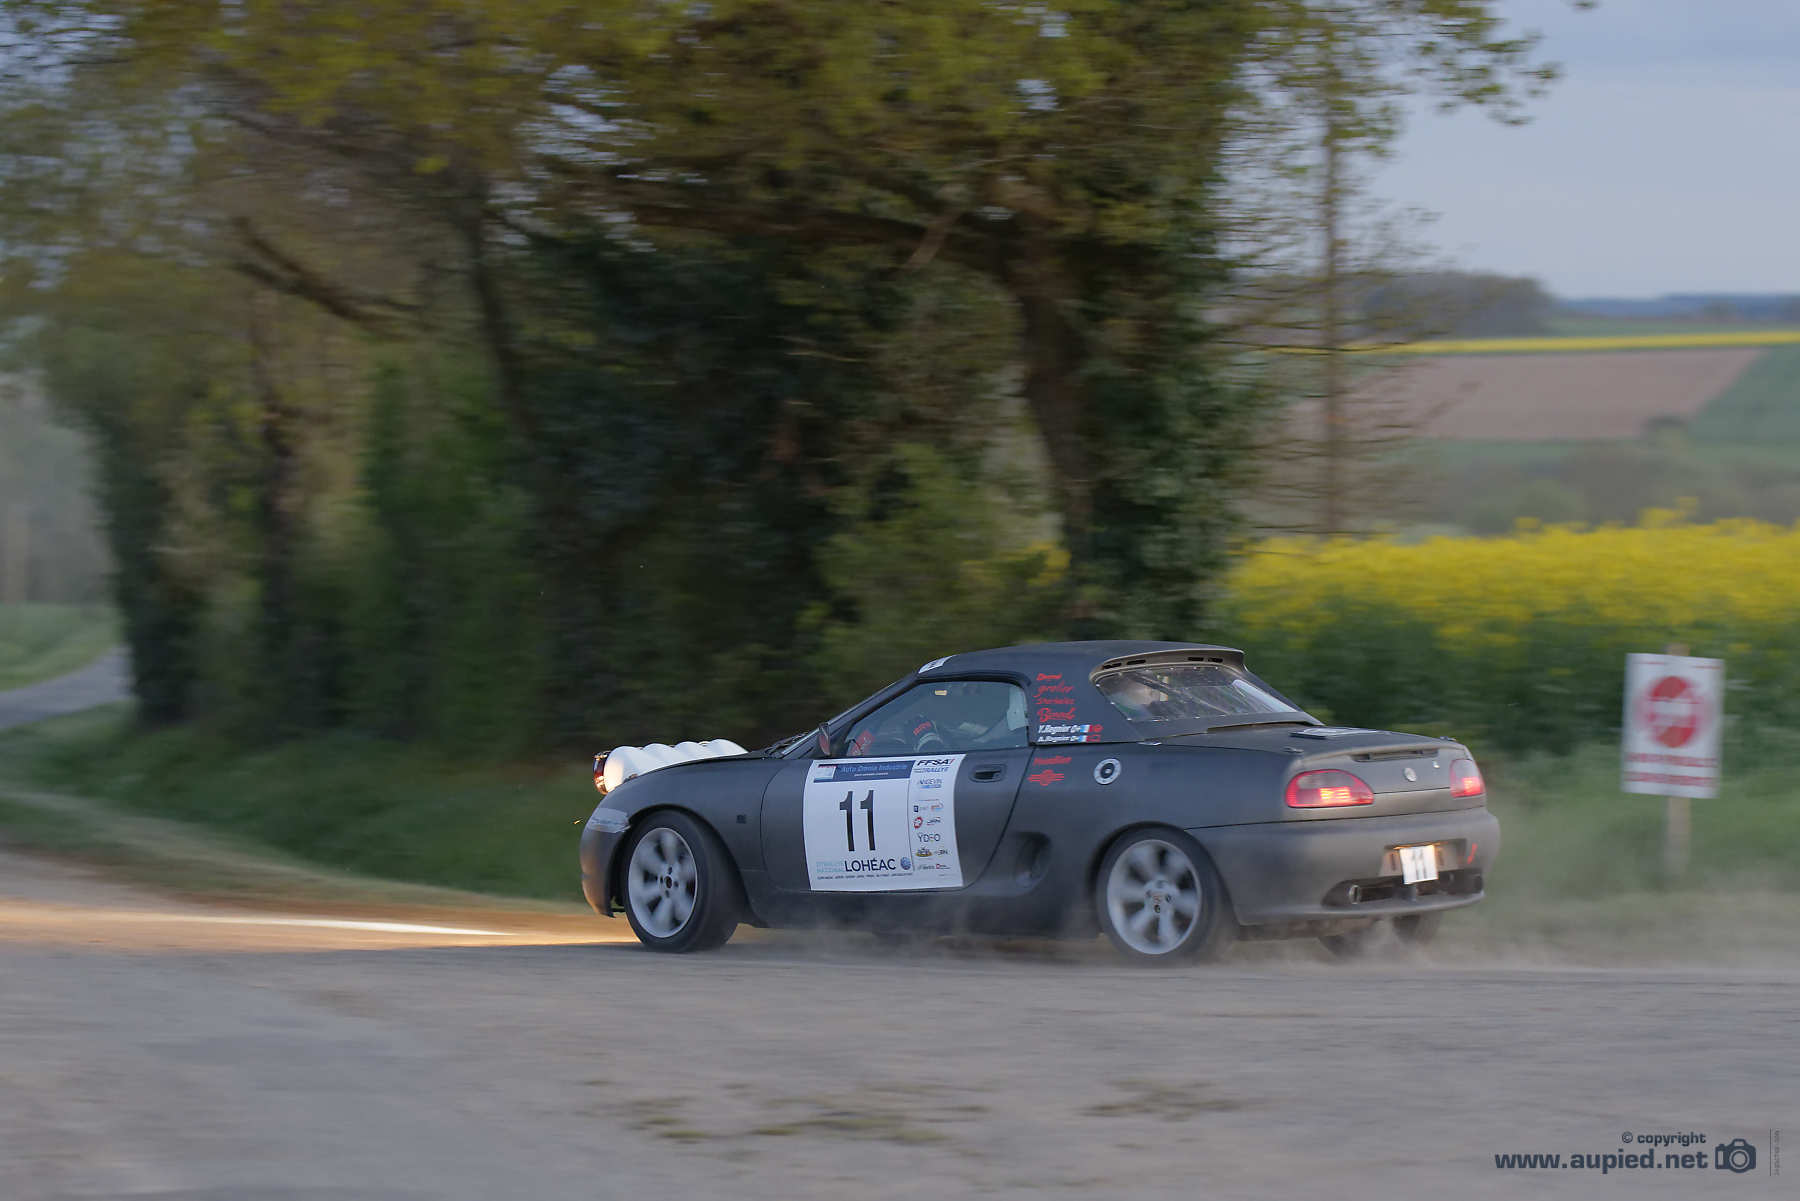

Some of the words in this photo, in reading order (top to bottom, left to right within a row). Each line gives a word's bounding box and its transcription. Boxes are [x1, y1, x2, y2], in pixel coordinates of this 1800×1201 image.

[917, 758, 949, 766] FFSA
[839, 789, 876, 852] 11
[844, 858, 896, 872] LOHÉAC
